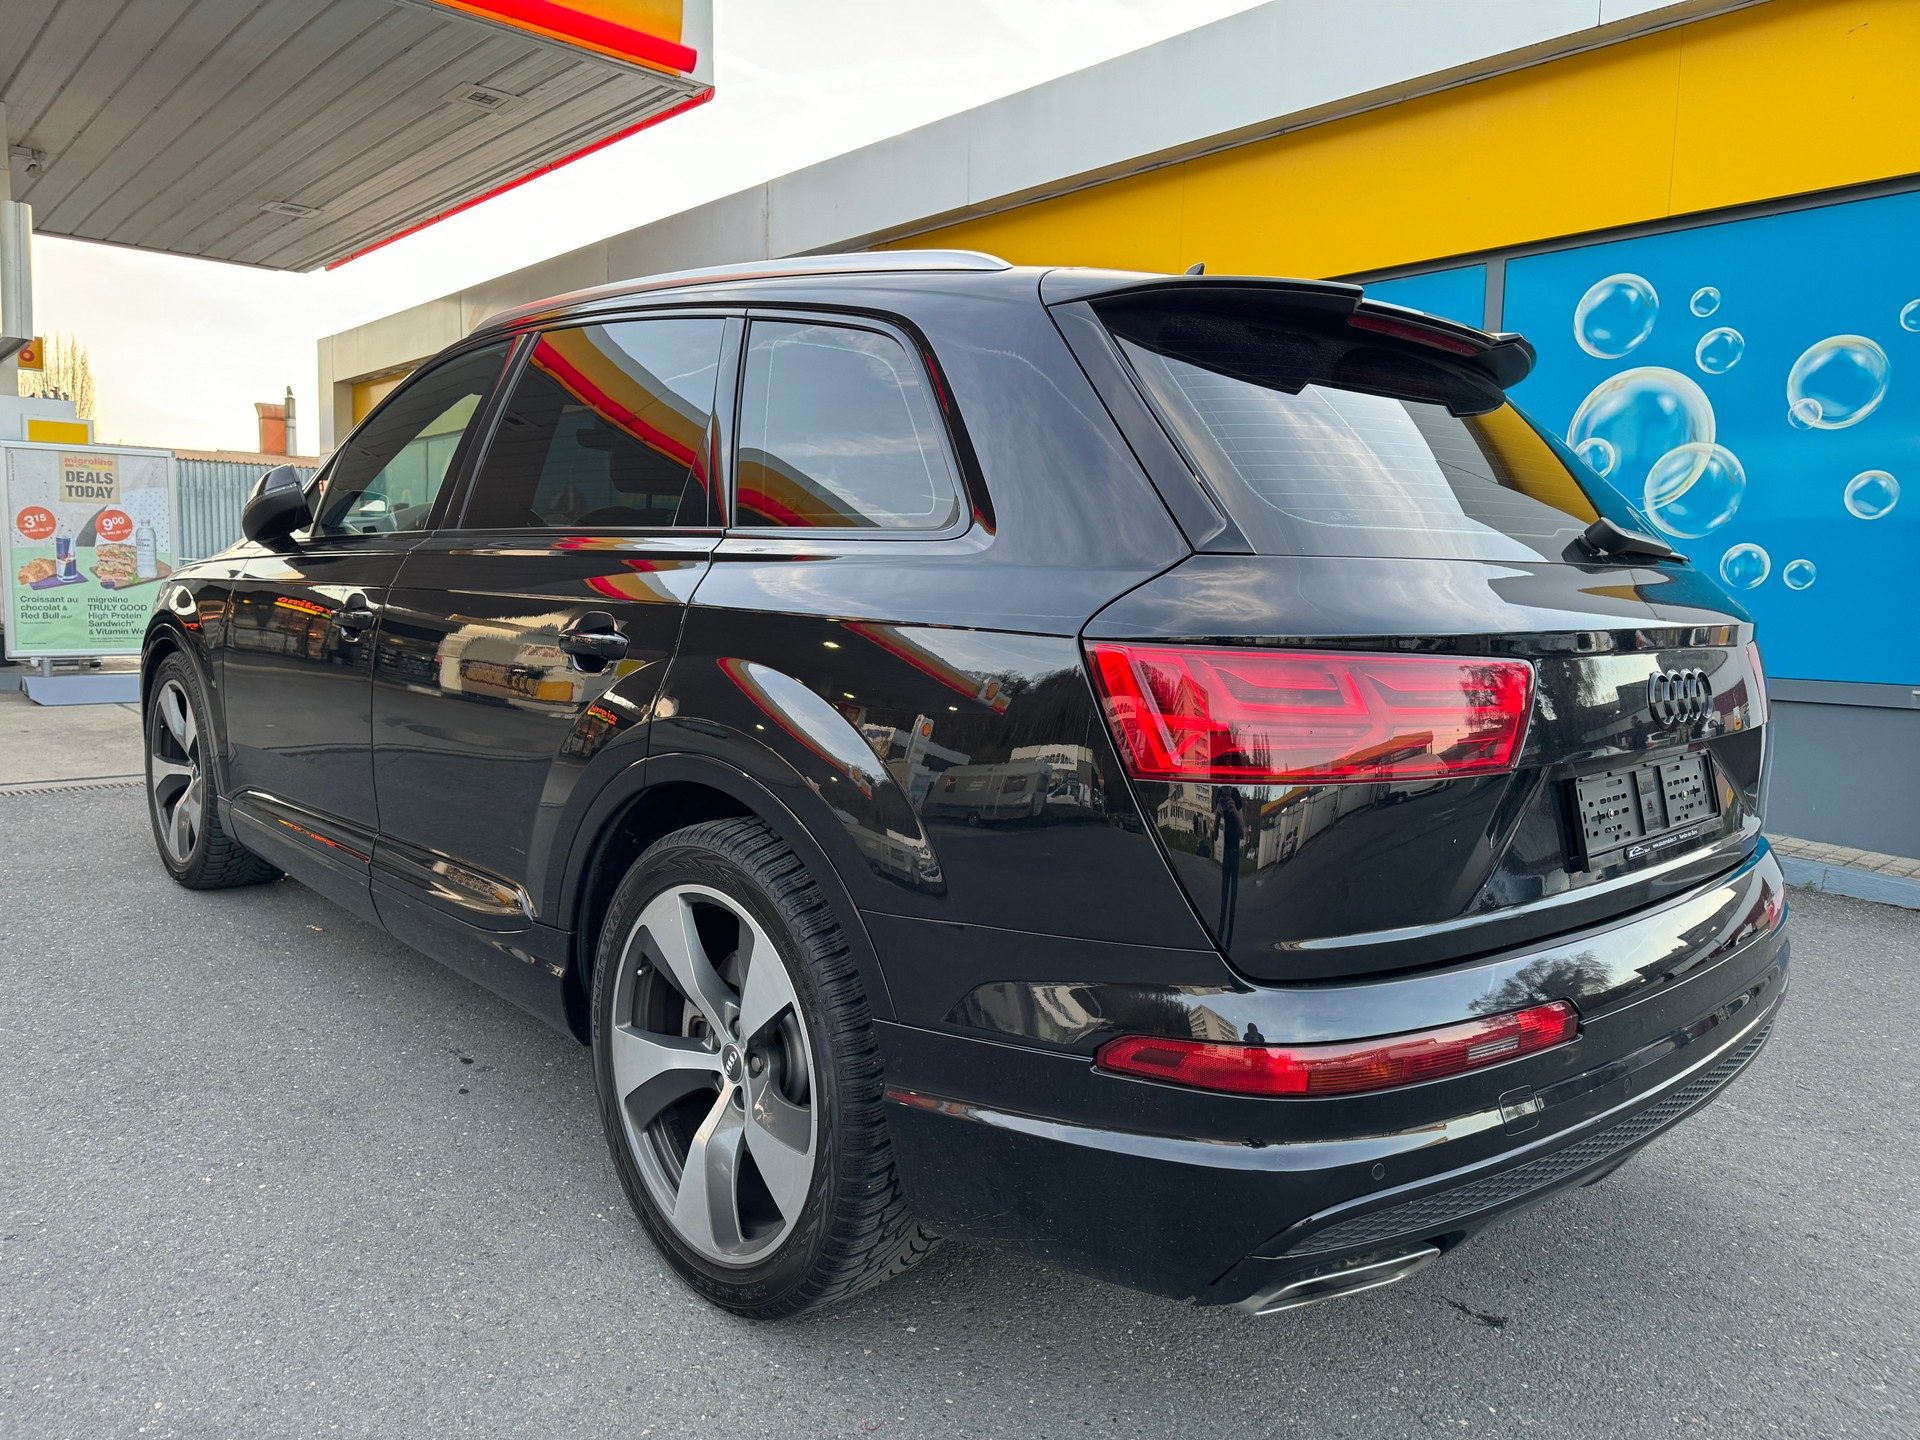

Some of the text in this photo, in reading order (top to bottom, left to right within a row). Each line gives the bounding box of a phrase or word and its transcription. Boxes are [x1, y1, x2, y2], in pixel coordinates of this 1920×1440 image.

[64, 456, 113, 467] migrolino
[65, 470, 113, 485] DEALS
[65, 485, 113, 499] TODAY
[20, 595, 64, 603] Croissant
[87, 595, 129, 604] migrolino
[88, 612, 109, 620] High
